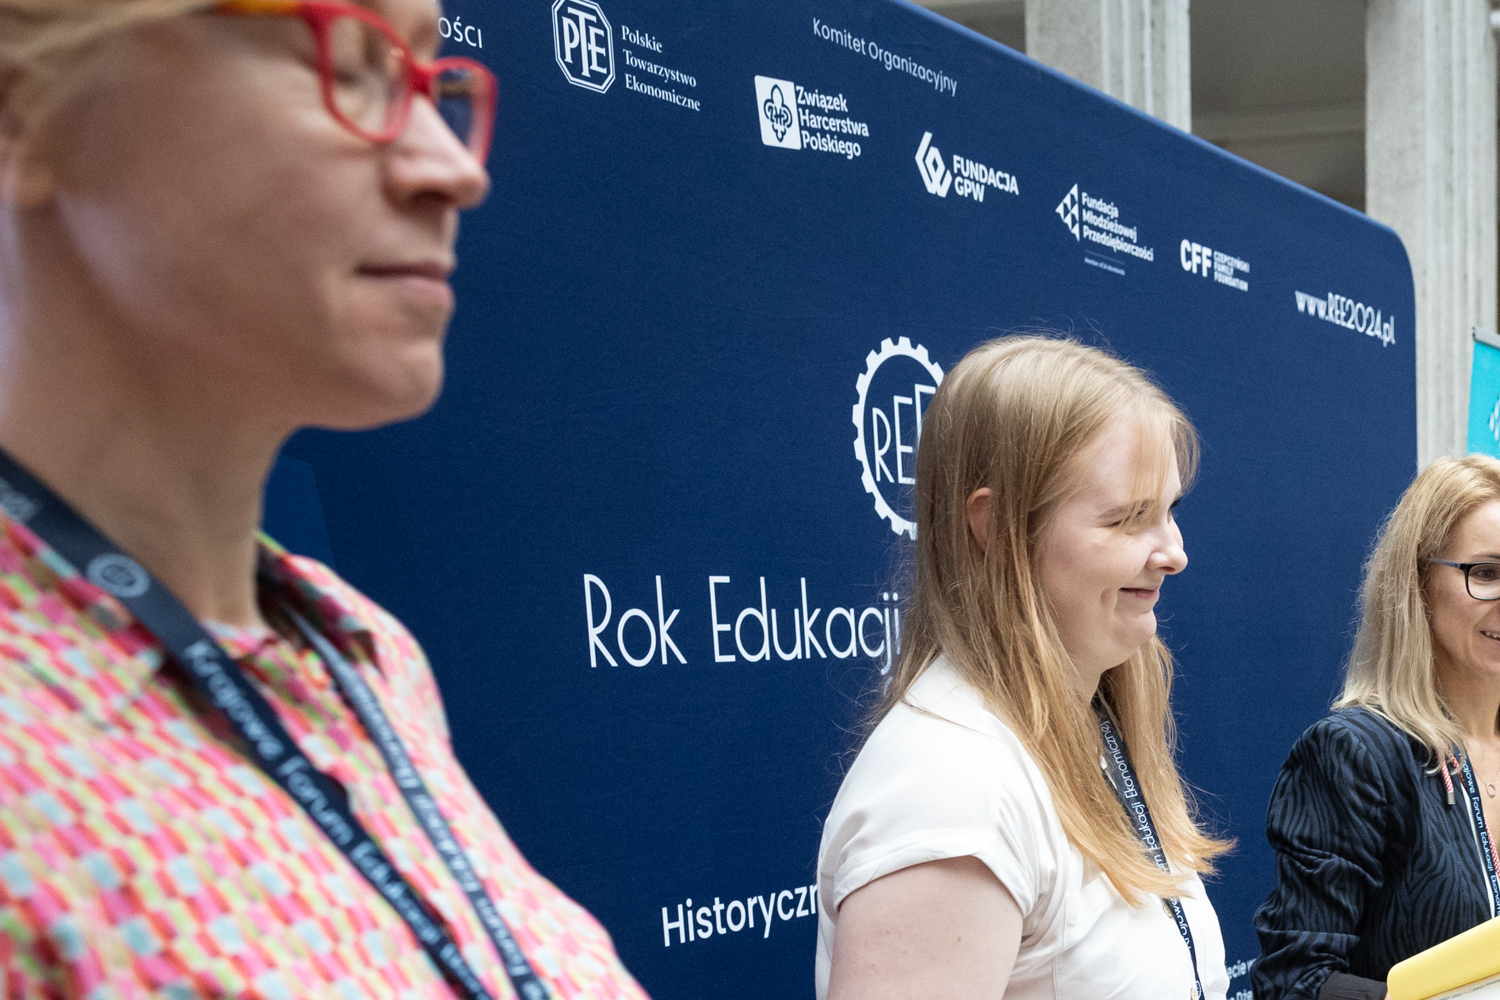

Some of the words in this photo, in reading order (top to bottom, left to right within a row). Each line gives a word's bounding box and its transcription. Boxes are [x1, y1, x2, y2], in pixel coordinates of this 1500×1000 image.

[621, 25, 663, 53] Polskie
[813, 17, 867, 55] Komitet
[868, 42, 957, 97] Organizacyjny
[622, 49, 697, 87] Towarzystwo
[624, 73, 700, 111] Ekonomiczne
[796, 85, 848, 113] Związek
[799, 108, 869, 137] Harcerstwa
[801, 130, 861, 160] Polskiego
[953, 154, 1019, 195] FUNDACJA
[954, 176, 985, 202] GPW
[1081, 191, 1119, 218] Fundacja
[1082, 208, 1137, 243] Młodzieżowej
[1083, 225, 1154, 261] Przedsiębiorczości
[1180, 239, 1212, 277] CFF
[1295, 290, 1396, 347] www.REE2024.pl
[583, 573, 688, 668] Rok
[709, 575, 900, 676] Edukacji
[1100, 720, 1138, 799] Ekonomicznej
[1131, 803, 1158, 851] Edukacji
[1472, 796, 1483, 829] Forum
[1480, 831, 1494, 872] Edukacji
